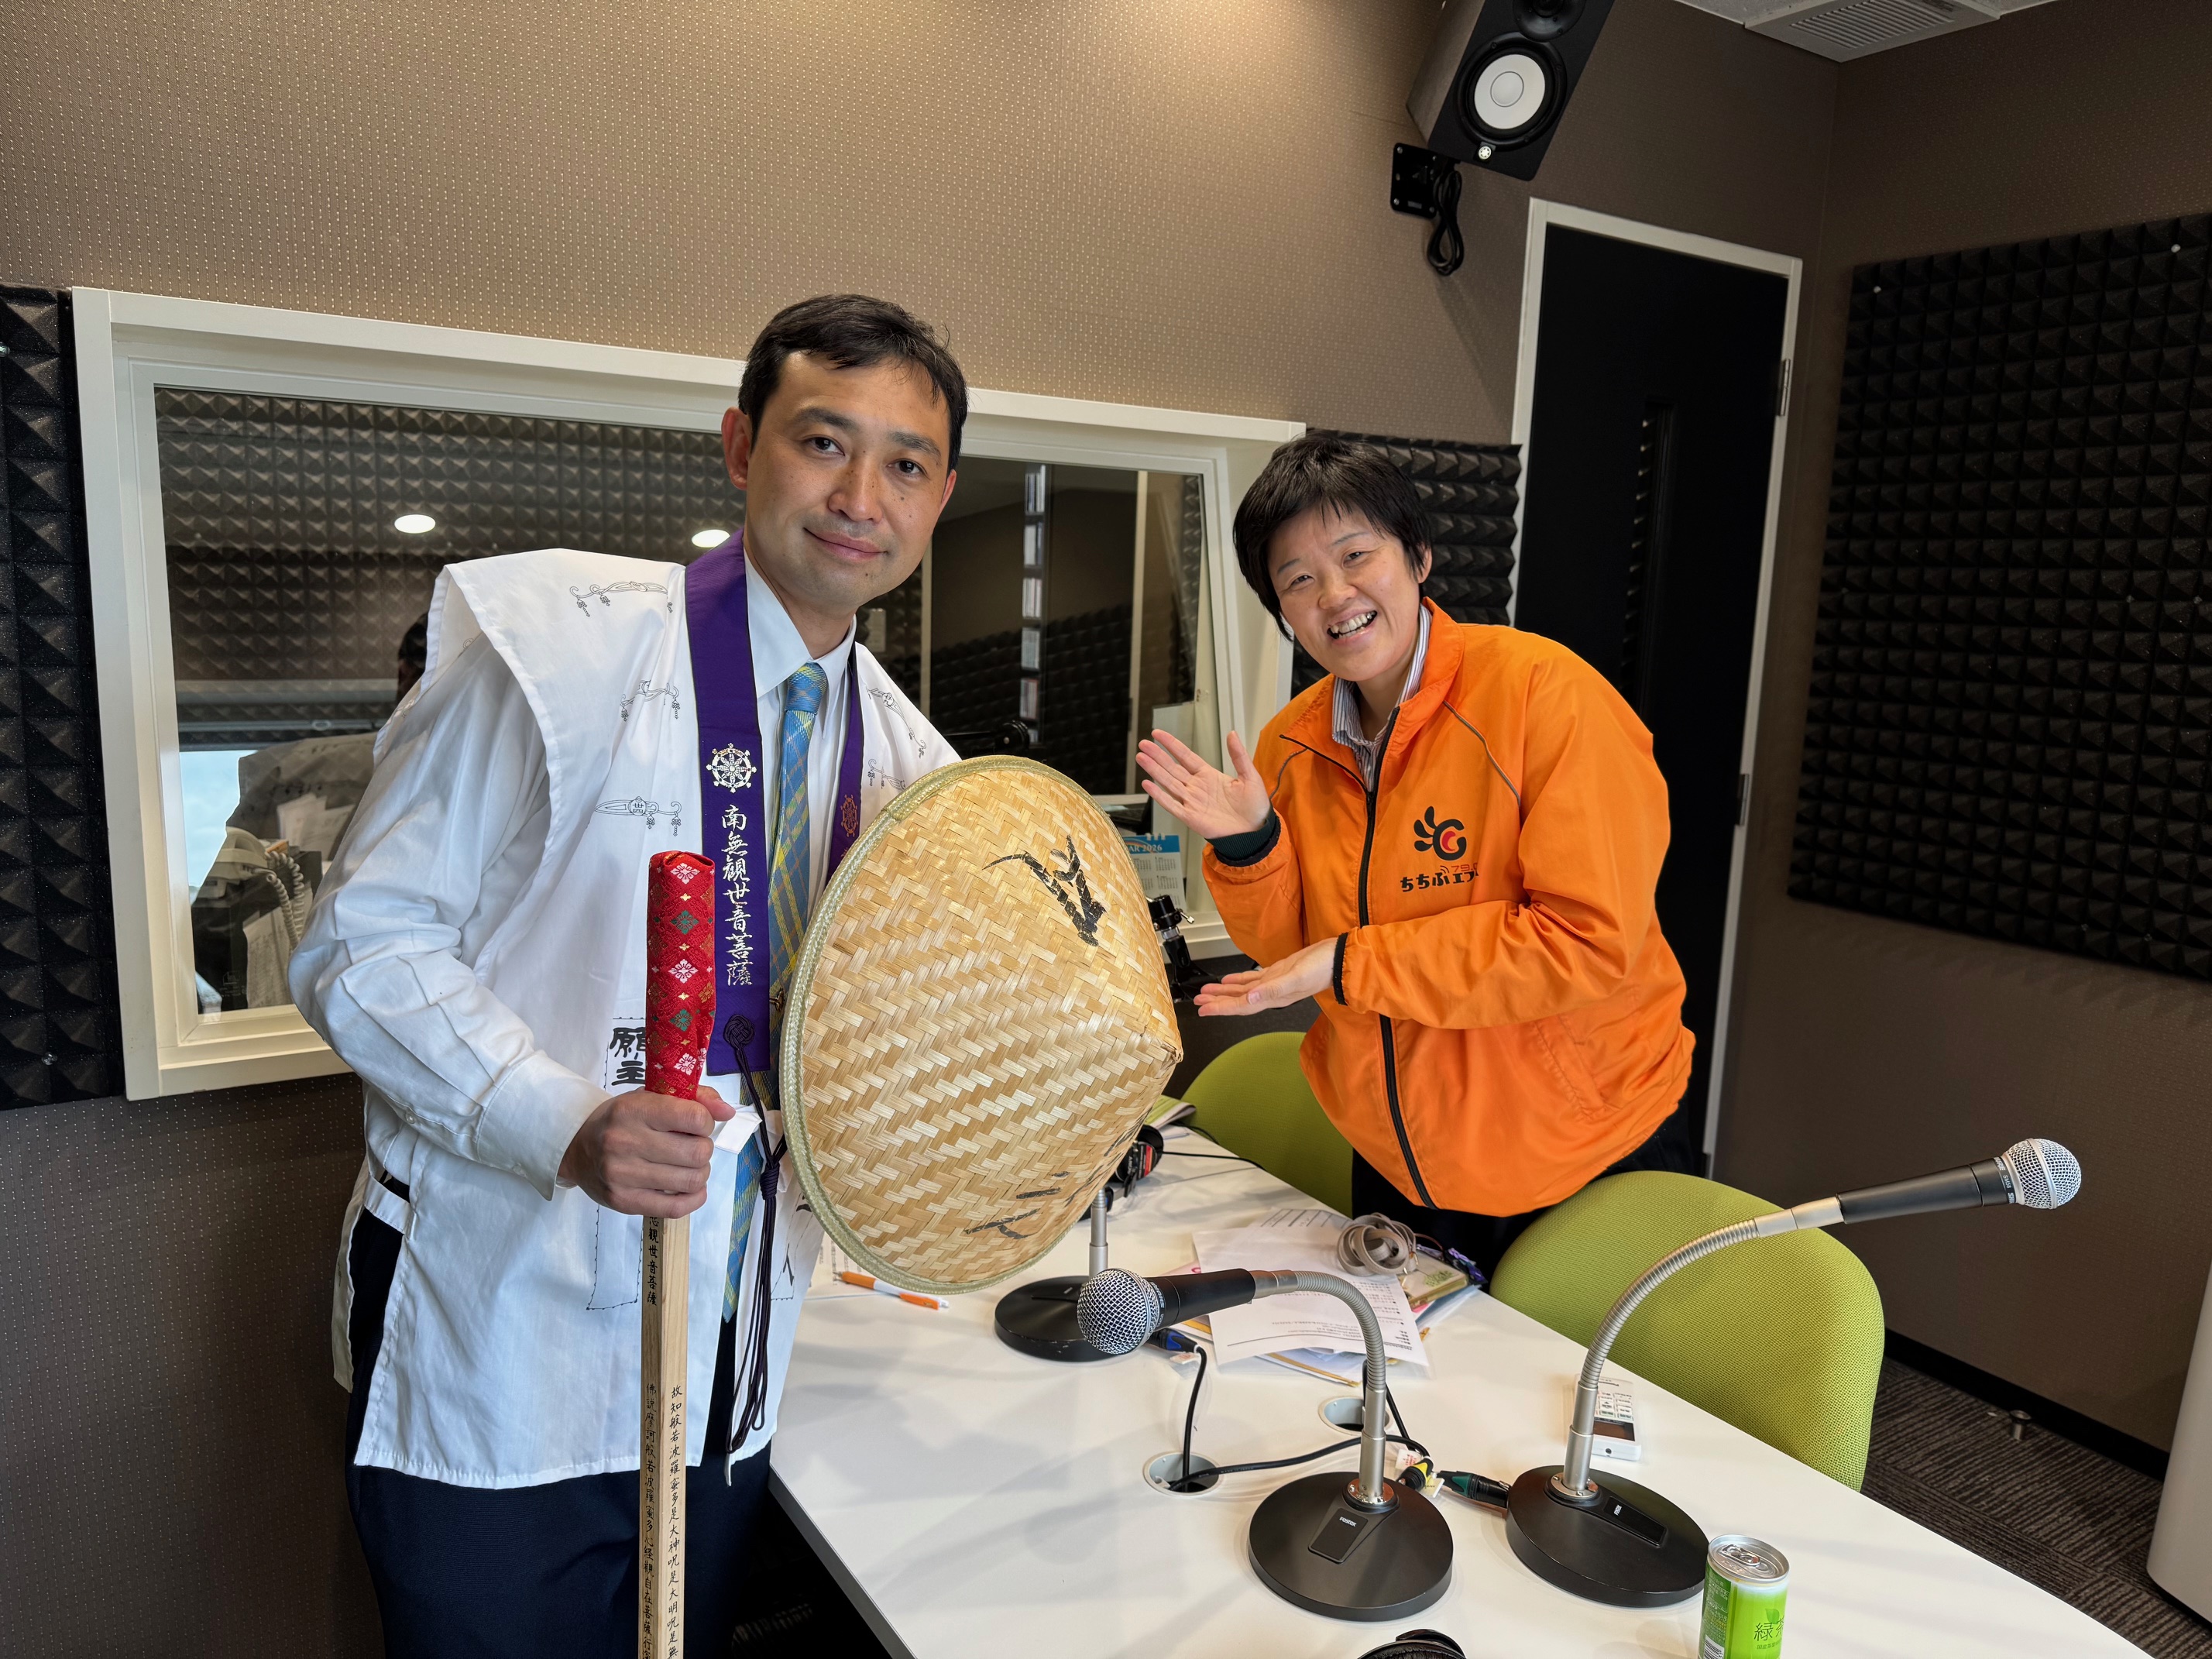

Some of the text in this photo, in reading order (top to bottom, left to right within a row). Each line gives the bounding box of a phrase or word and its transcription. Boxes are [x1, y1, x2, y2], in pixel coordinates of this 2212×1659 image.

[1400, 871, 1479, 892] ちちぶエフ
[720, 804, 754, 987] 南無観世音菩薩
[2003, 1175, 2012, 1189] SM58
